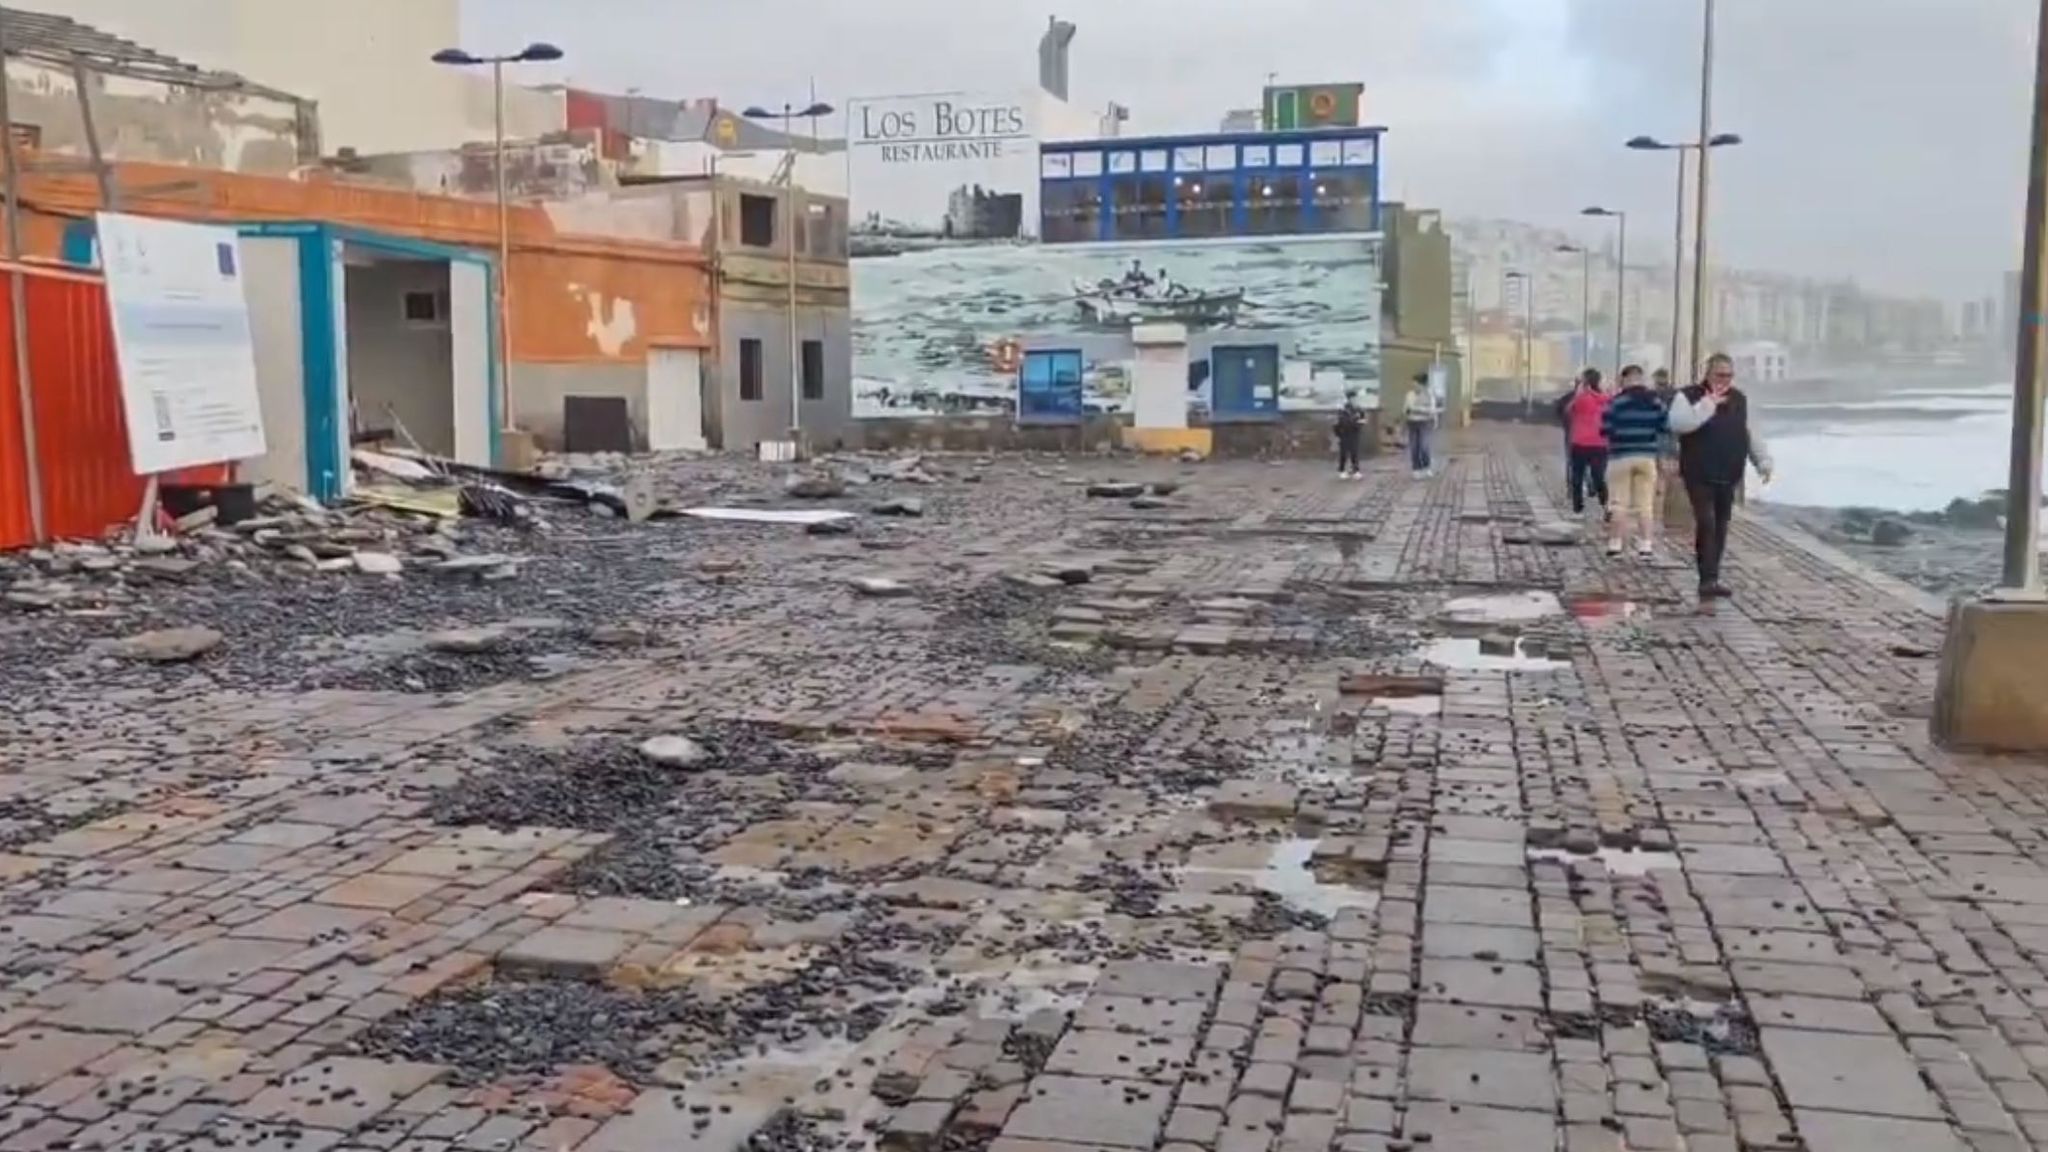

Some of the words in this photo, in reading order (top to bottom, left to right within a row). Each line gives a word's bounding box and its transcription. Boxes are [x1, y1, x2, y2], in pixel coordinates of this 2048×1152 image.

[863, 106, 916, 139] LOS
[935, 102, 1023, 136] BOTES
[882, 141, 1002, 163] RESTAURANTE
